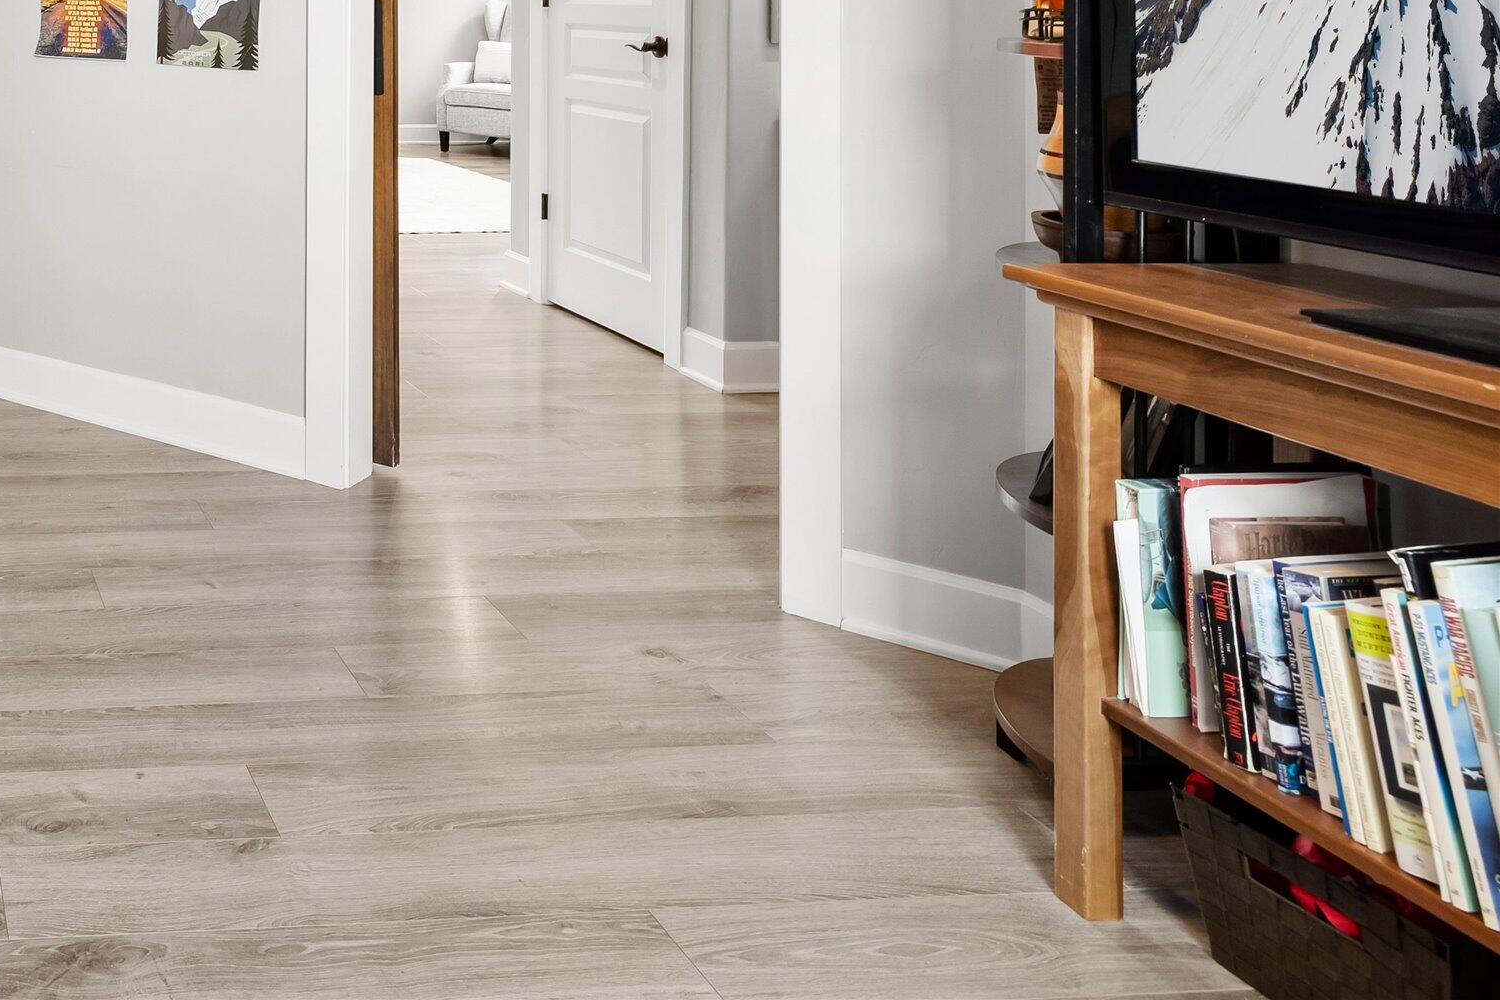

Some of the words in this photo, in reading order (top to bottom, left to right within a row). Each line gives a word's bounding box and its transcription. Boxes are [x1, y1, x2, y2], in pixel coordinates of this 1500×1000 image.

[1274, 571, 1286, 592] The
[1209, 580, 1229, 621] Clapton
[1277, 592, 1291, 615] Last
[1438, 593, 1458, 615] AIR
[1281, 617, 1293, 639] Year
[1411, 611, 1425, 632] P-51
[1445, 614, 1466, 640] WAR
[1285, 639, 1296, 652] of
[1415, 630, 1433, 667] MUSTANG
[1288, 652, 1299, 670] the
[1450, 638, 1476, 683] PACIFIC
[1223, 672, 1240, 695] Eric
[1424, 664, 1438, 686] ACES
[1224, 697, 1243, 739] Clapton
[1400, 672, 1419, 714] FIGHTER
[1411, 715, 1426, 742] ACES
